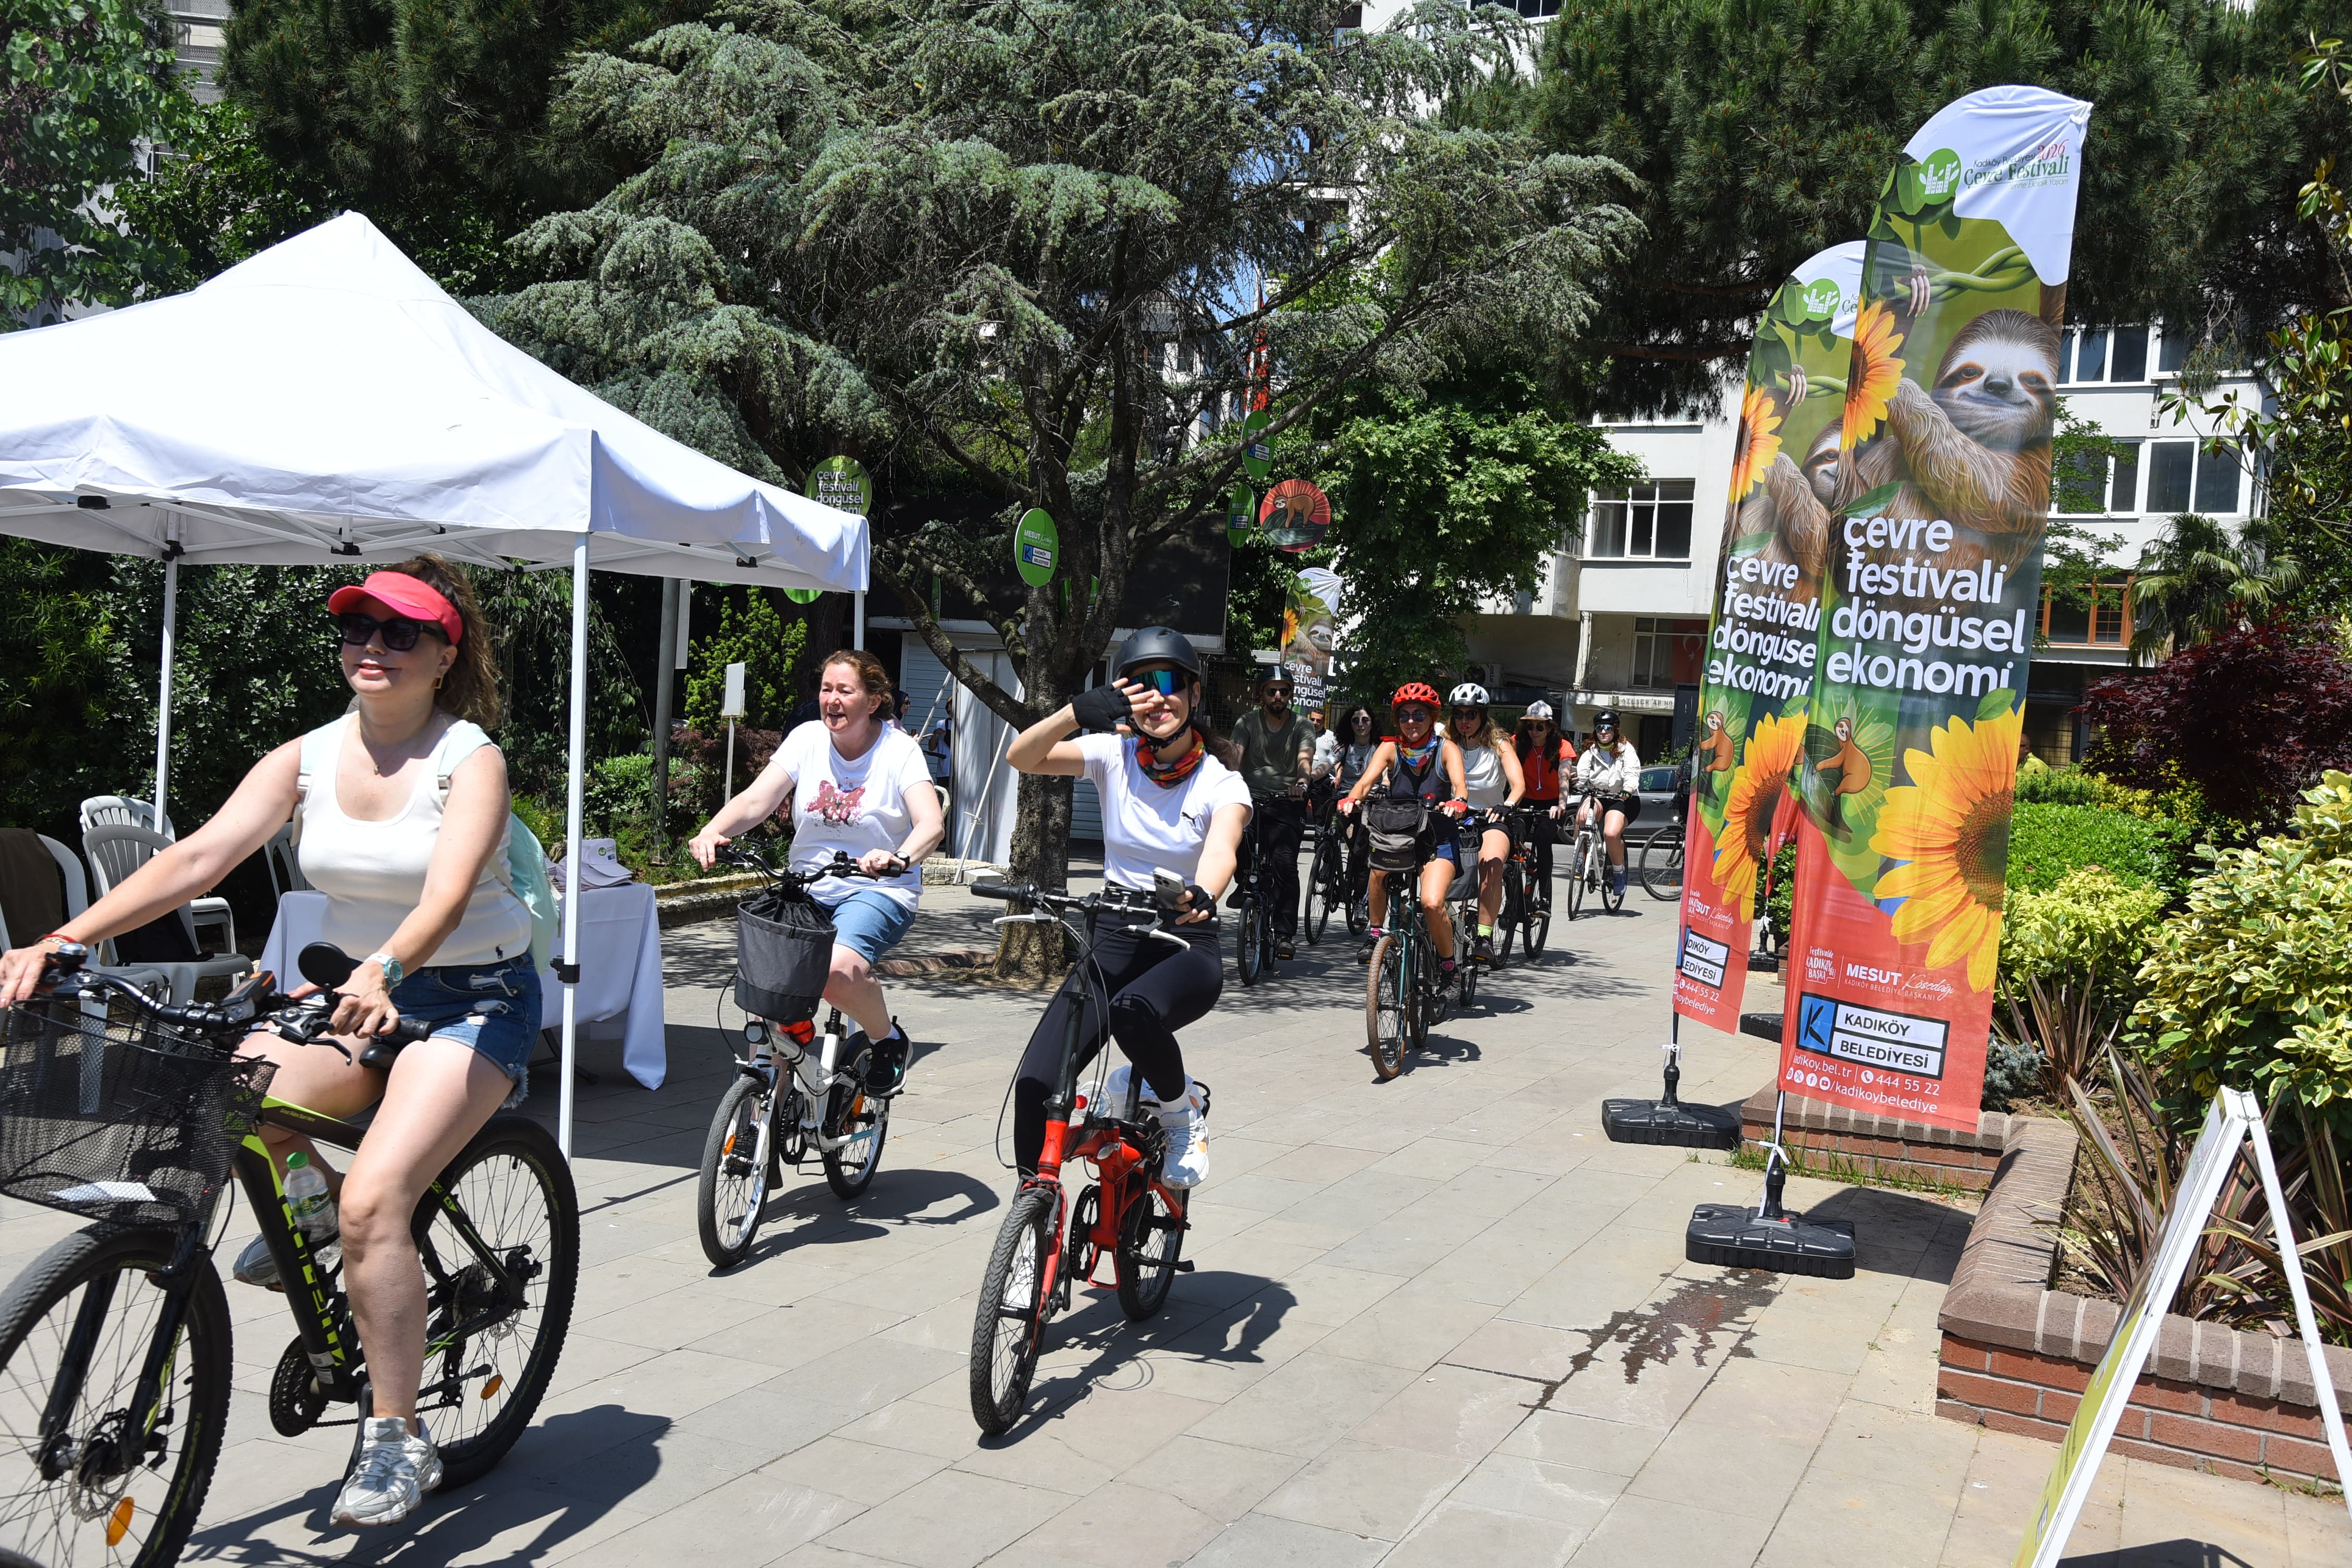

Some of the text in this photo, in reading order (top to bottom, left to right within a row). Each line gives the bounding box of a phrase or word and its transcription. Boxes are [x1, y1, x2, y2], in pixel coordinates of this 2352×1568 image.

[2037, 139, 2069, 160] 2026
[1964, 154, 2069, 189] Çevre Festivali
[1973, 158, 2001, 167] Kadıköy
[817, 471, 847, 481] çevre
[818, 480, 859, 492] festivali
[815, 492, 864, 506] döngüsel
[1843, 517, 1953, 555] çevre
[1726, 555, 1799, 590] çevre
[1846, 550, 2007, 604] festivali
[1832, 596, 2026, 654] döngüsel
[1713, 617, 1817, 668] döngüse
[1708, 654, 1814, 700] ekonomi
[1827, 642, 2014, 697] ekonomi
[1293, 685, 1326, 699] ngüsel
[1687, 939, 1710, 955] DIKÖY
[1809, 946, 1834, 958] Festivalde
[1806, 955, 1833, 971] KADIKÖY
[1808, 970, 1826, 981] BAŞKA
[1846, 963, 1955, 1001] MESUT Kösedağı
[1685, 982, 1719, 1002] 444 55 22
[1844, 978, 1935, 1000] KADIKÖY BELEDİYE BAŞKANI
[1844, 1013, 1911, 1036] KADIKÖY
[1840, 1040, 1930, 1069] BELEDİYESİ
[1876, 1074, 1899, 1088] 444
[1904, 1079, 1920, 1092] 55
[1924, 1083, 1940, 1096] 22
